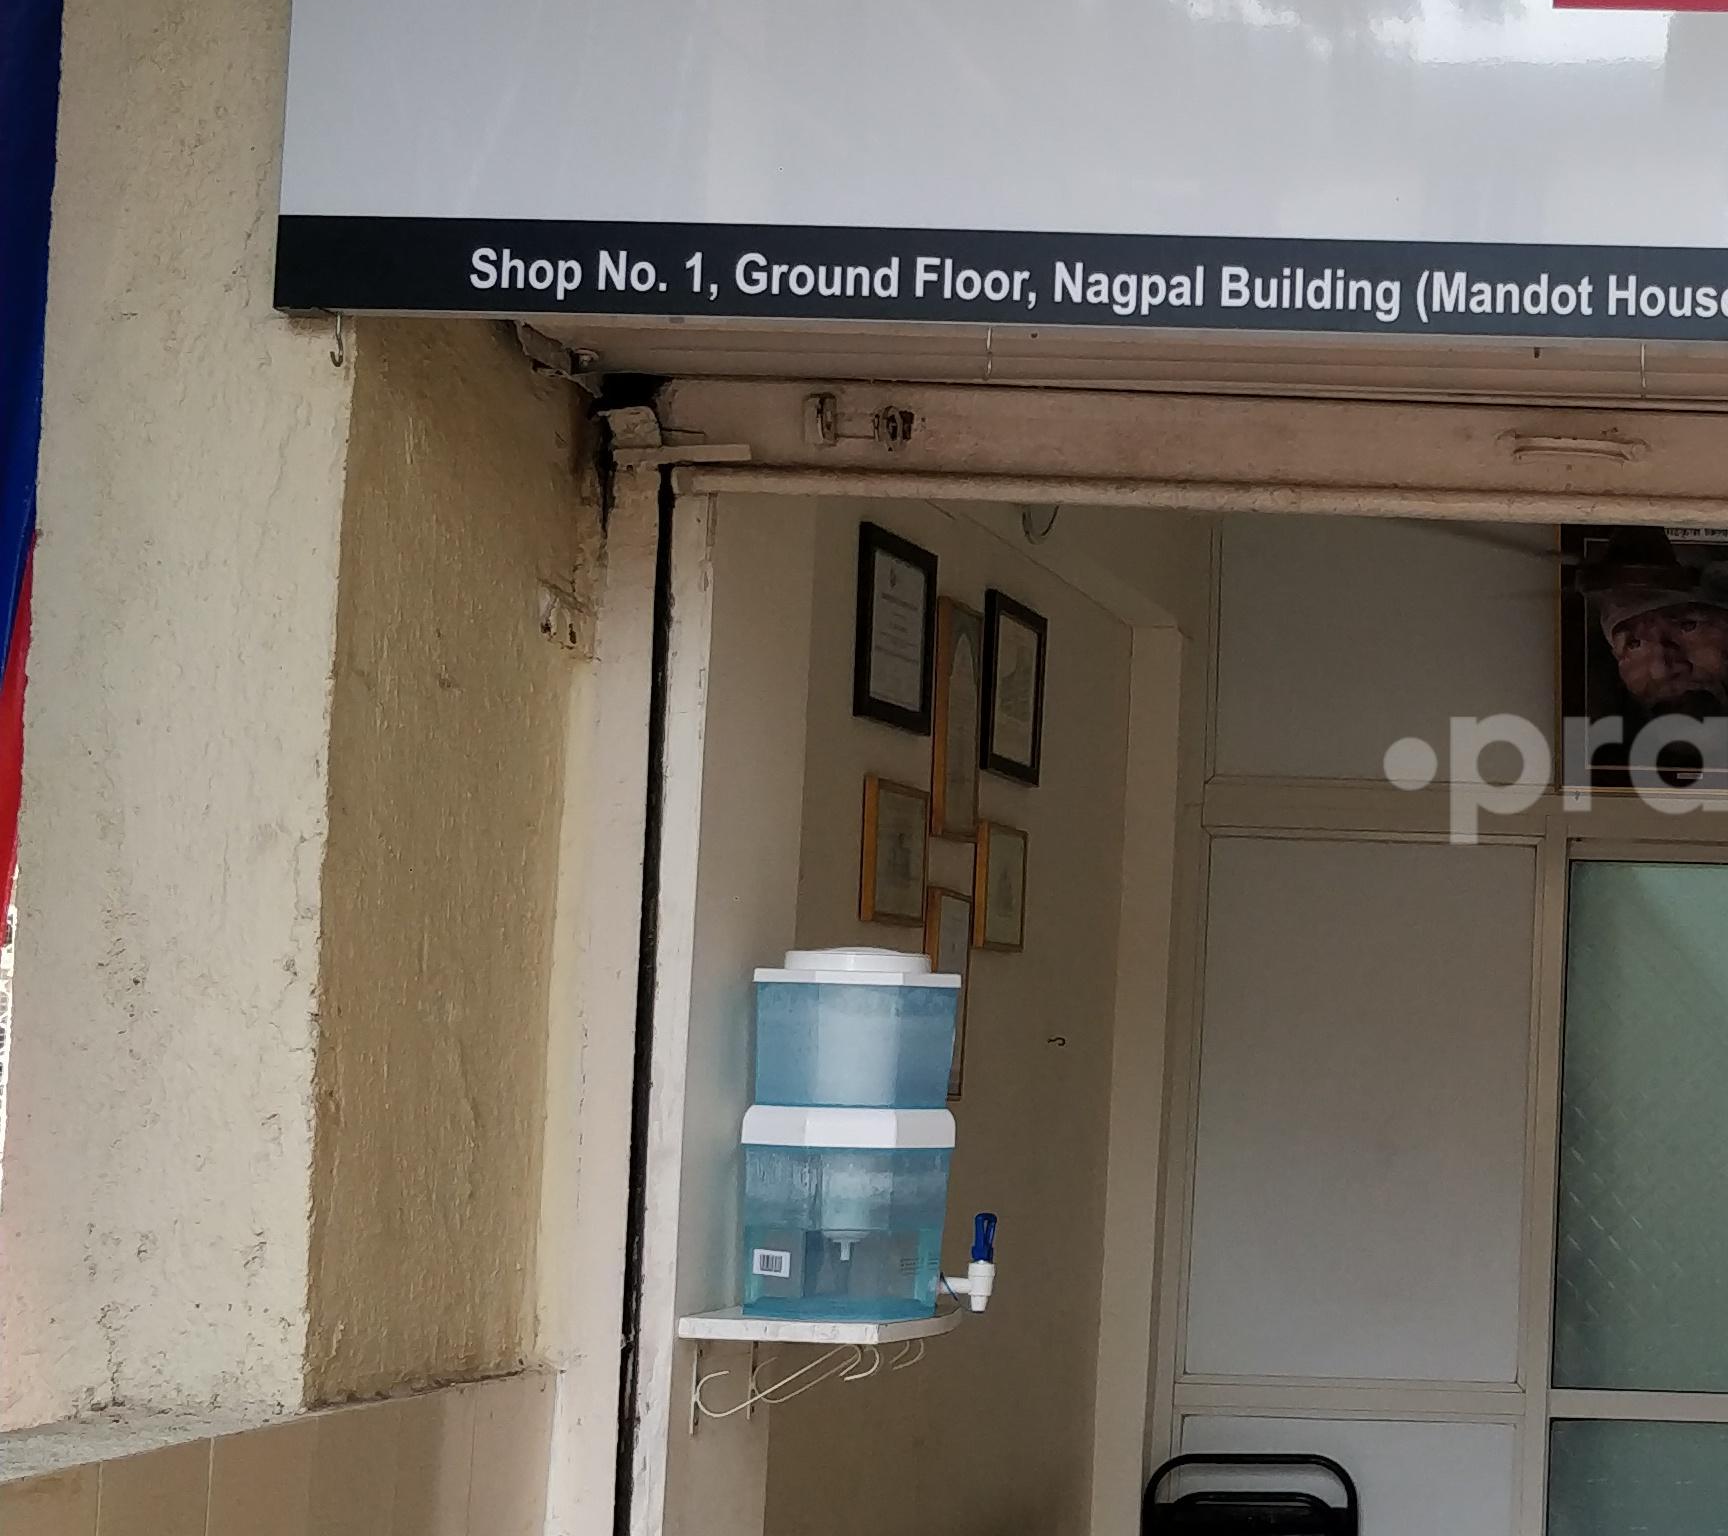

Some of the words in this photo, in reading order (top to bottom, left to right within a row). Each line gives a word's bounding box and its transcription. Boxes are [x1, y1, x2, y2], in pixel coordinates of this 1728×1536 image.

[469, 247, 582, 301] Shop
[597, 250, 667, 292] No.
[685, 251, 718, 301] 1,
[735, 252, 900, 298] Ground
[915, 256, 1037, 310] Floor,
[1054, 261, 1205, 316] Nagpal
[1220, 265, 1401, 322] Building
[1416, 269, 1593, 323] (Mandot
